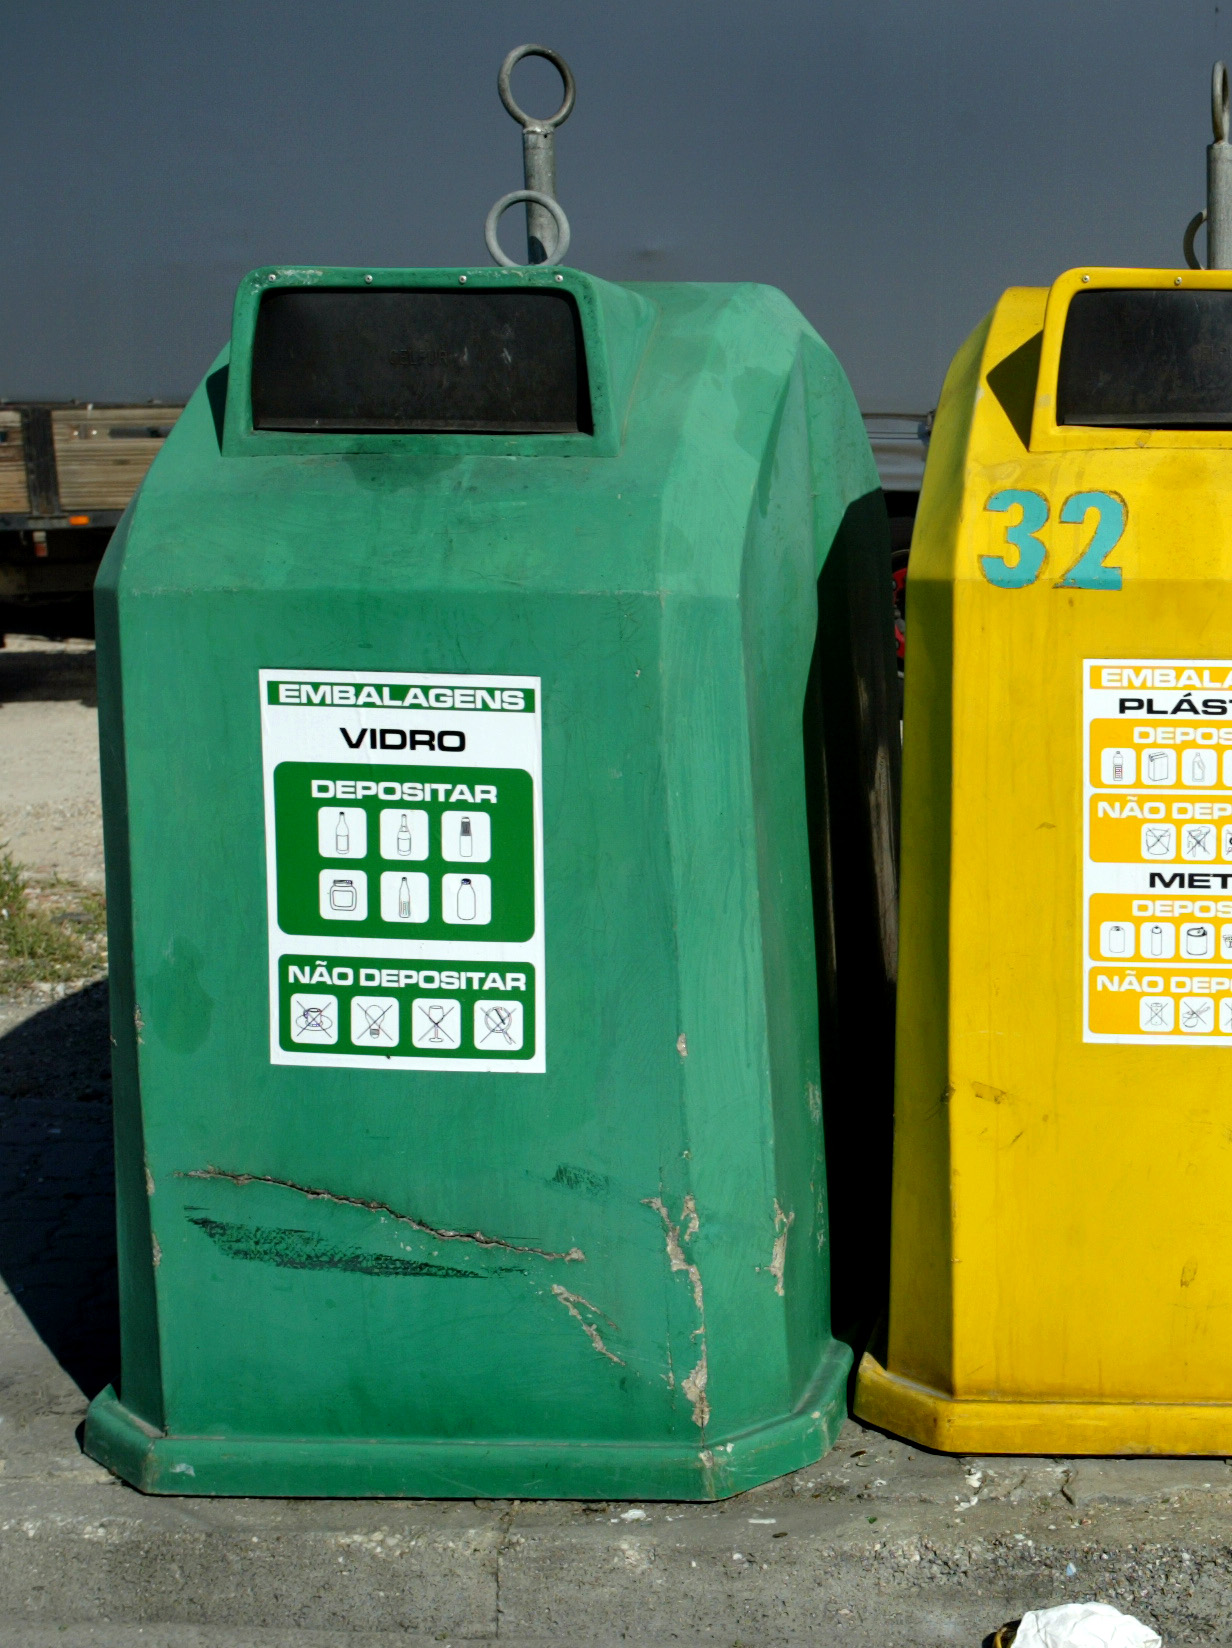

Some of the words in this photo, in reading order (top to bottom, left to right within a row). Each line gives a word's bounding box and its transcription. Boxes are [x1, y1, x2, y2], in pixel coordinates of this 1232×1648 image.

[978, 488, 1128, 590] 32
[279, 684, 525, 711] EMBALAGENS
[340, 727, 466, 752] VIDRO
[311, 779, 498, 804] DEPOSITAR
[1097, 795, 1166, 819] NÃO
[288, 960, 354, 986] NÃO
[359, 967, 526, 992] DEPOSITAR
[1096, 970, 1164, 993] NÃO
